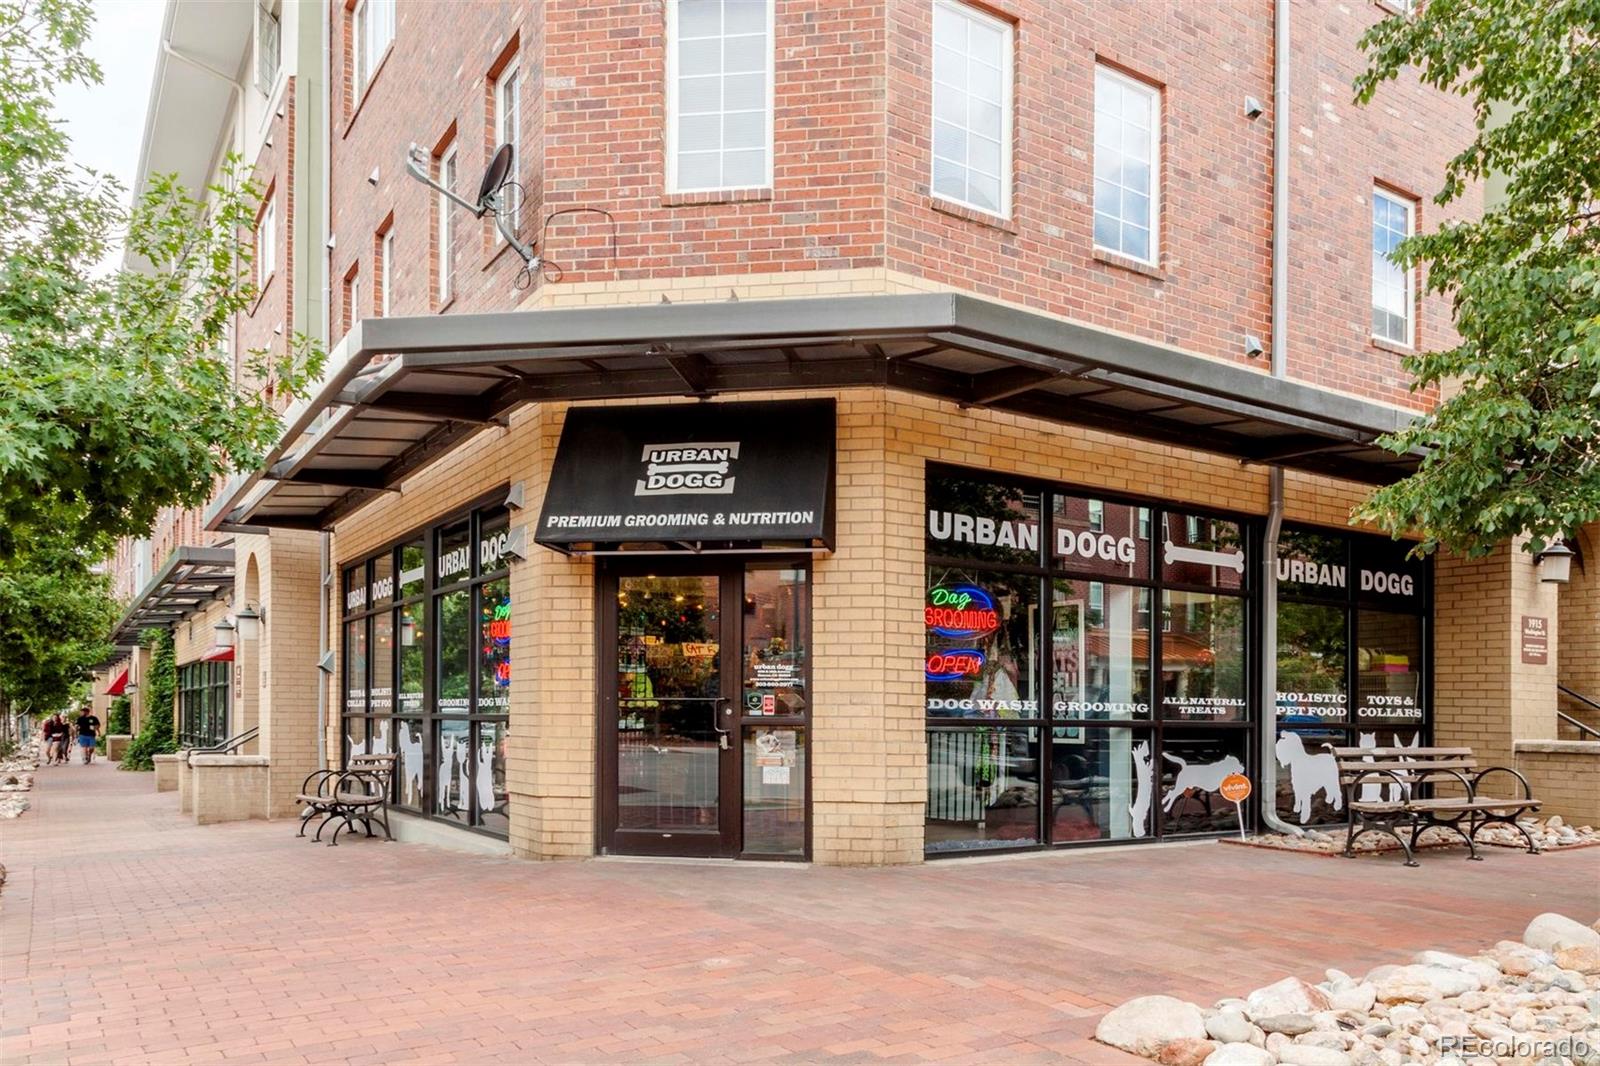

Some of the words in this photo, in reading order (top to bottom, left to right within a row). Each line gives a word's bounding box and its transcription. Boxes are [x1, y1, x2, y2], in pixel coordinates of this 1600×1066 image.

[650, 449, 728, 463] URBAN
[647, 473, 723, 489] DOGG
[547, 514, 622, 528] PREMIUM
[624, 513, 708, 527] GROOMING
[713, 512, 725, 525] &
[729, 511, 814, 525] NUTRITION
[929, 510, 1038, 552] URBAN
[1057, 528, 1136, 563] DOGG
[1276, 558, 1346, 588] URBAN
[1360, 569, 1414, 596] DOGG
[932, 588, 972, 610] Dog
[925, 607, 997, 629] GROOMING
[1528, 618, 1542, 629] 1915
[928, 655, 981, 674] OPEN
[478, 697, 493, 707] DOG
[1163, 696, 1188, 706] ALL
[1188, 697, 1246, 707] NATURAL
[1276, 691, 1347, 704] HOLISTIC
[1367, 695, 1402, 706] TOYS
[1403, 695, 1414, 705] &
[928, 698, 974, 711] DOG
[977, 699, 1038, 712] WASH
[1054, 701, 1150, 714] GROOMING
[1179, 706, 1226, 715] TREATS
[1275, 706, 1309, 717] PET
[1310, 706, 1347, 717] FOOD
[1358, 707, 1422, 718] COLLARS
